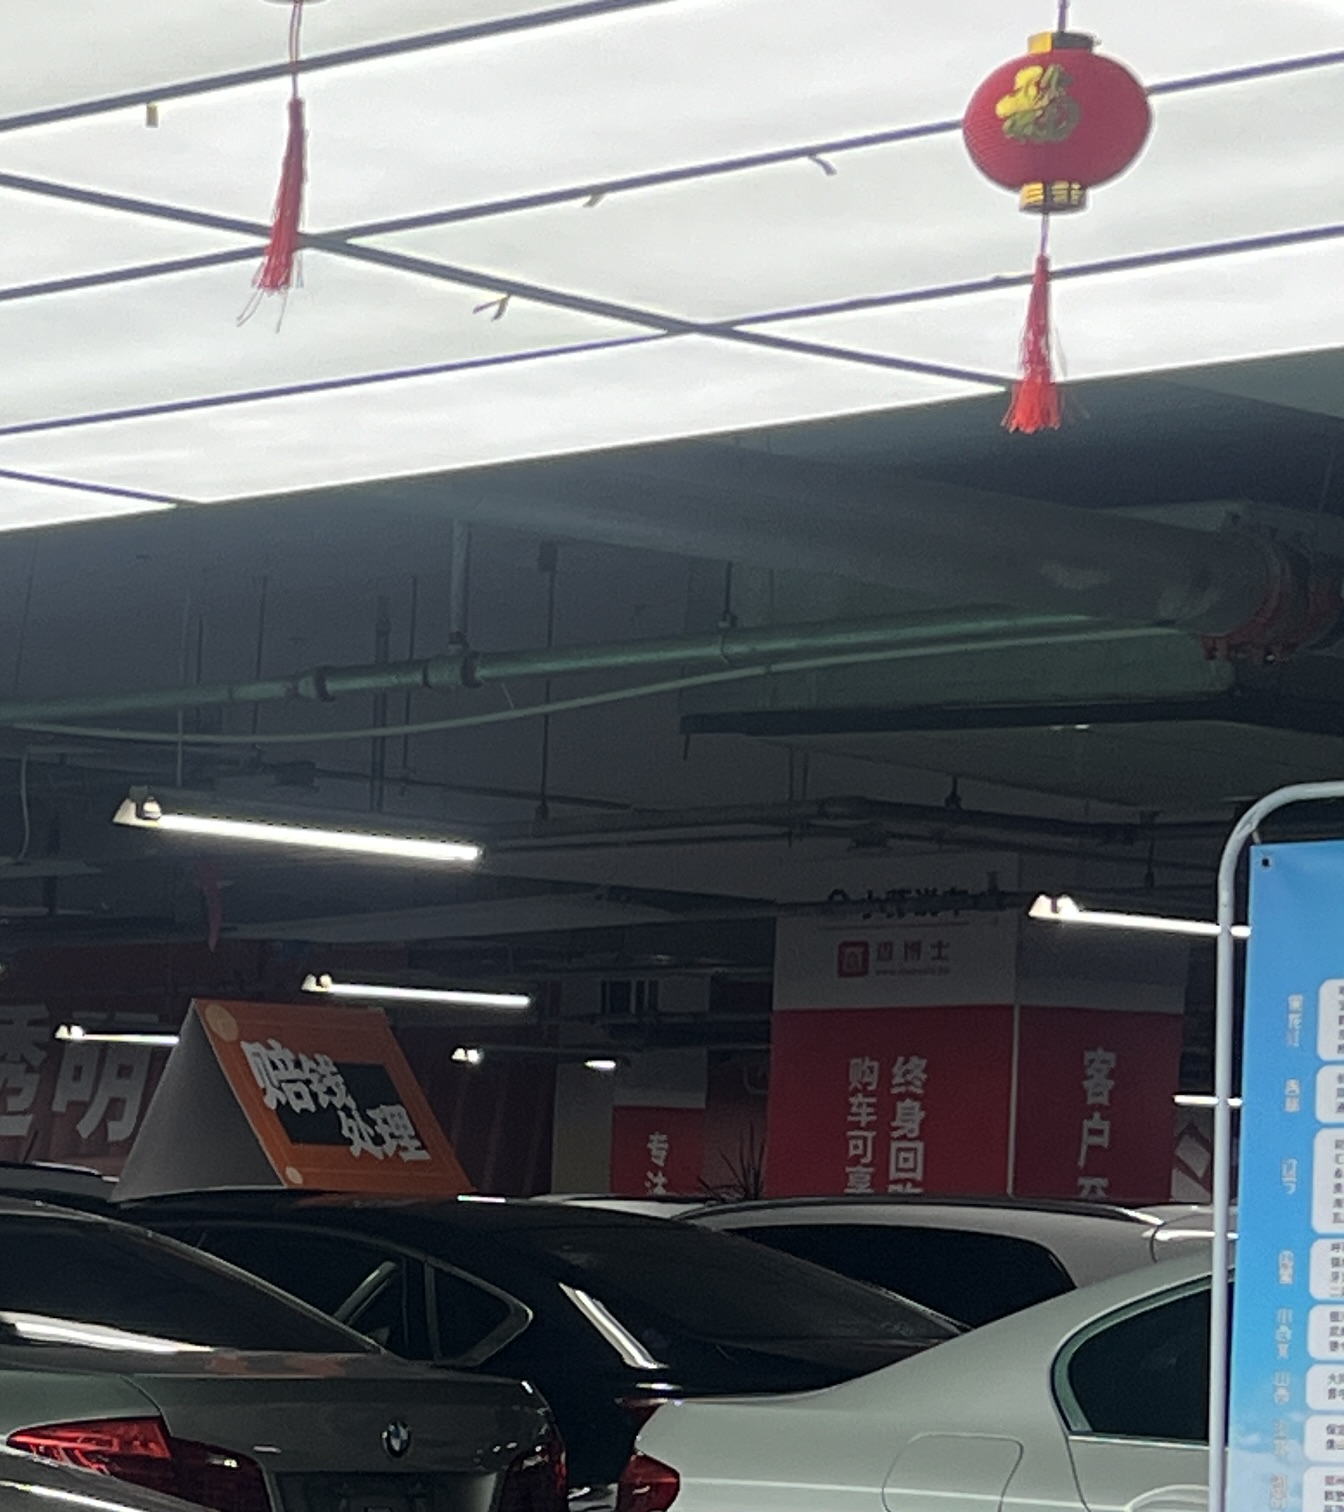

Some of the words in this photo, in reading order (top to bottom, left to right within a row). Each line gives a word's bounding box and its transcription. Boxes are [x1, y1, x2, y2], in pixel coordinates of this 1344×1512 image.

[338, 1103, 431, 1162] 处理
[887, 1055, 928, 1194] 终身回
